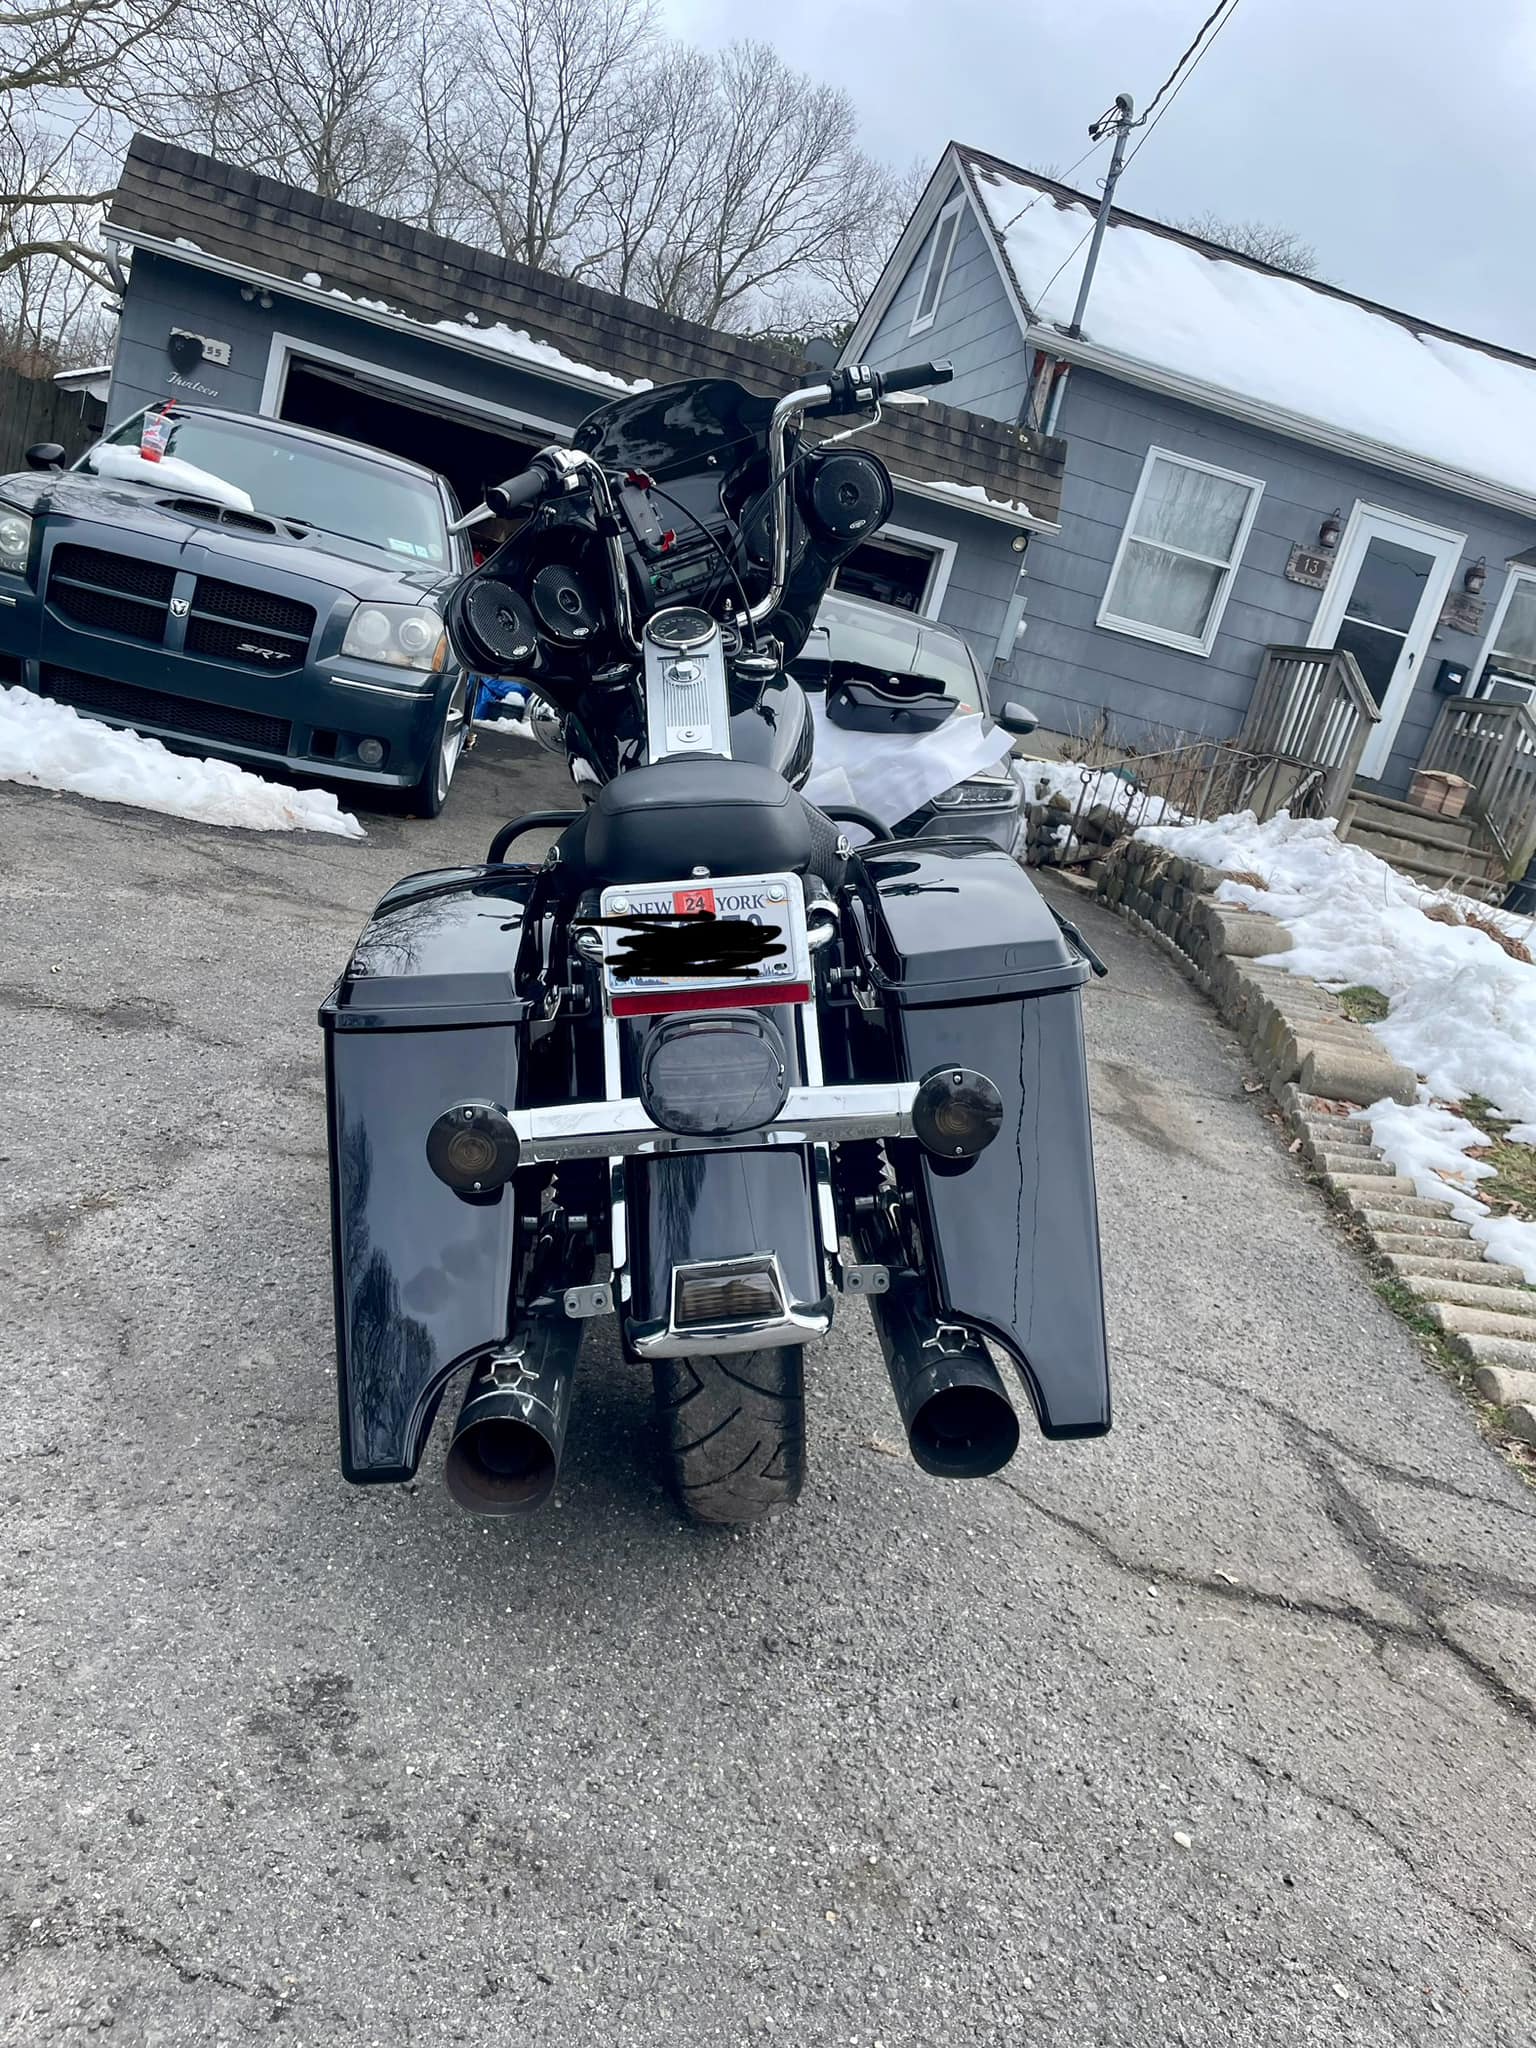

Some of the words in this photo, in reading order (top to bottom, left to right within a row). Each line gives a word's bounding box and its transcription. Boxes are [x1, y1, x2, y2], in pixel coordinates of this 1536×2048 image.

[1304, 558, 1320, 574] 13
[236, 643, 292, 660] SRT
[630, 901, 672, 914] NEW
[715, 893, 764, 911] YORK
[684, 896, 706, 911] 24
